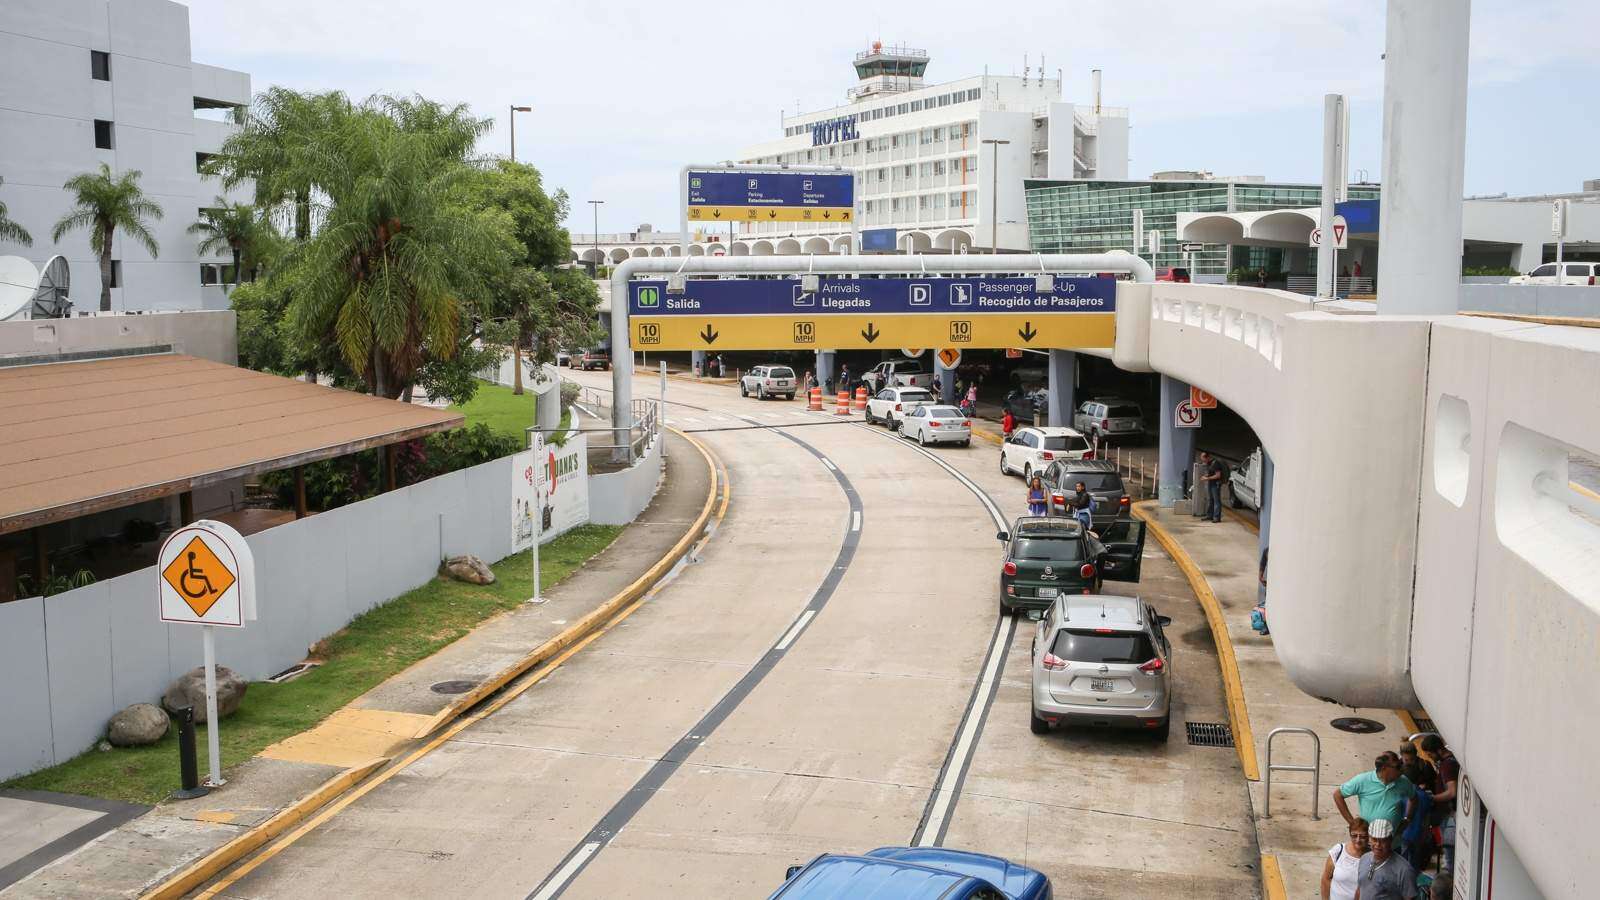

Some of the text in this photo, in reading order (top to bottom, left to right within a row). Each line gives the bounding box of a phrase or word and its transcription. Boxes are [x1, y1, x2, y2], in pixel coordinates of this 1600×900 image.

[812, 116, 860, 147] HOTEL
[822, 283, 860, 293] Arrivals
[979, 282, 1033, 295] Passenger
[913, 287, 927, 302] D
[666, 298, 701, 309] Salida
[822, 297, 871, 309] Llegadas
[979, 297, 1104, 308] Recogido de Pasajeros
[642, 325, 658, 337] 10
[796, 323, 812, 335] 10
[953, 322, 968, 334] 10
